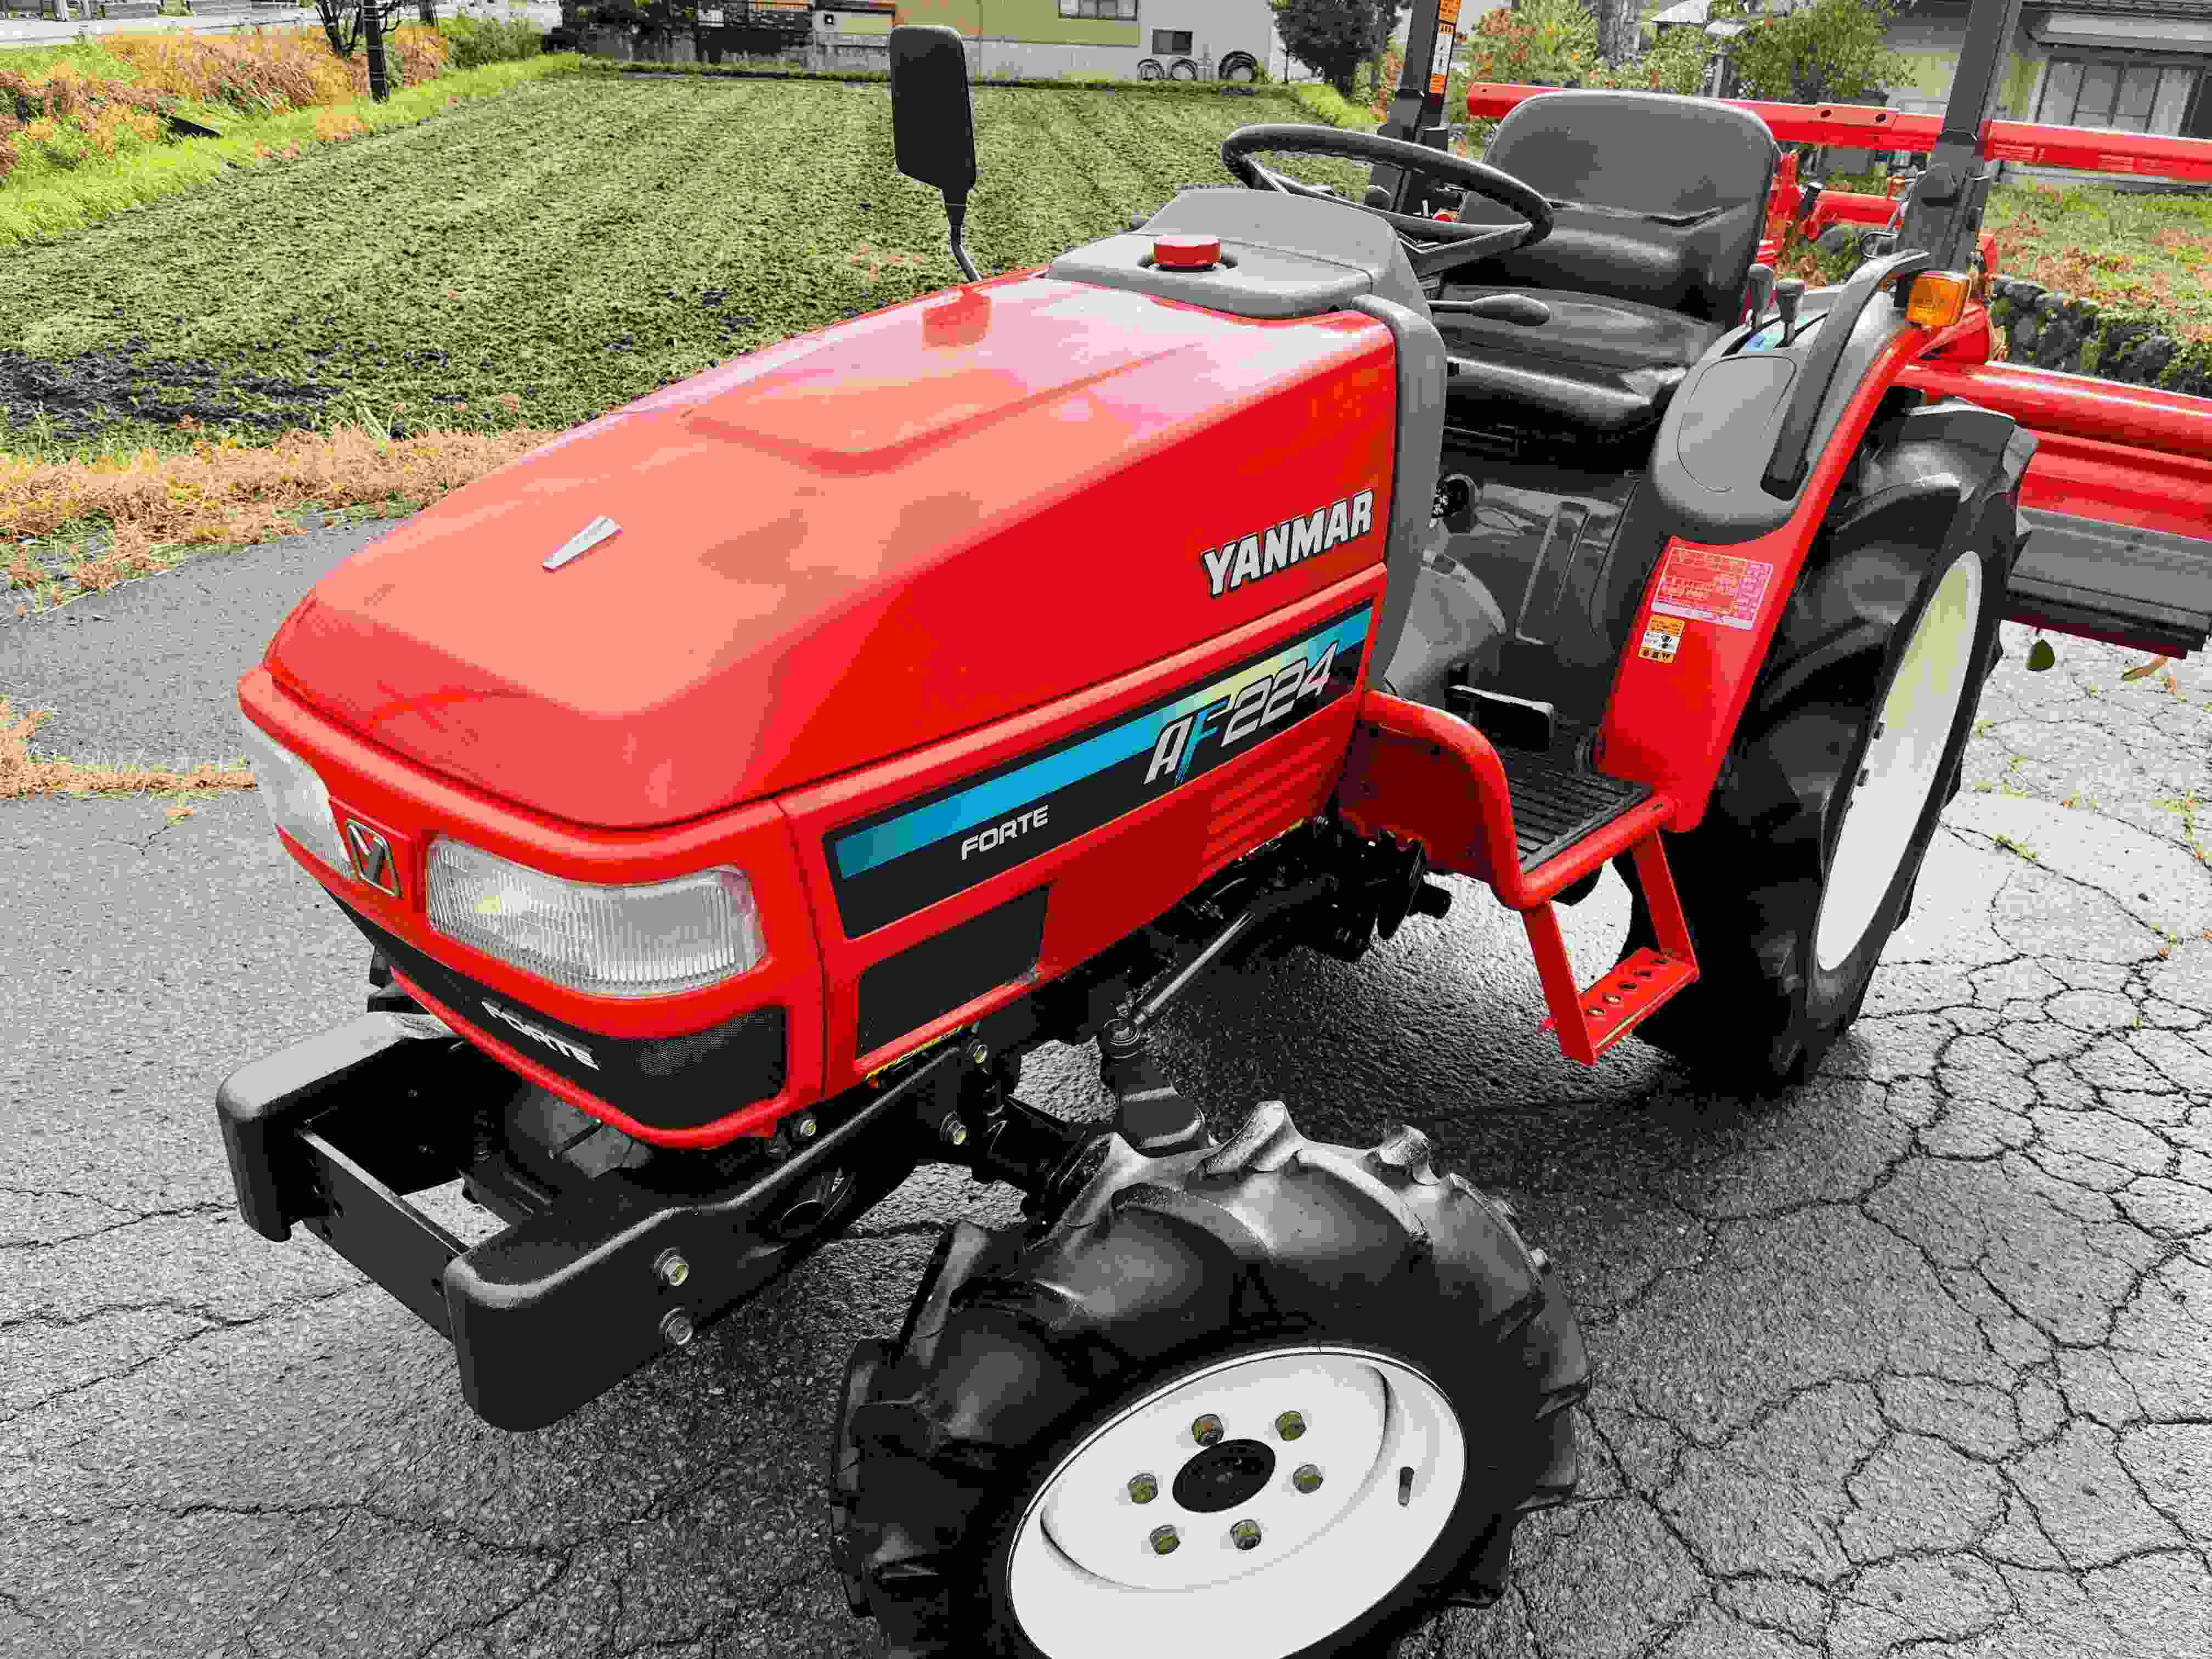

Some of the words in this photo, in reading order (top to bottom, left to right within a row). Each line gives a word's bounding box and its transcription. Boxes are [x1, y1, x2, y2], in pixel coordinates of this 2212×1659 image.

[1203, 488, 1373, 597] YANMAR
[1143, 640, 1339, 786] AF224
[961, 804, 1049, 860] FORTE
[481, 1001, 600, 1071] FORTE
